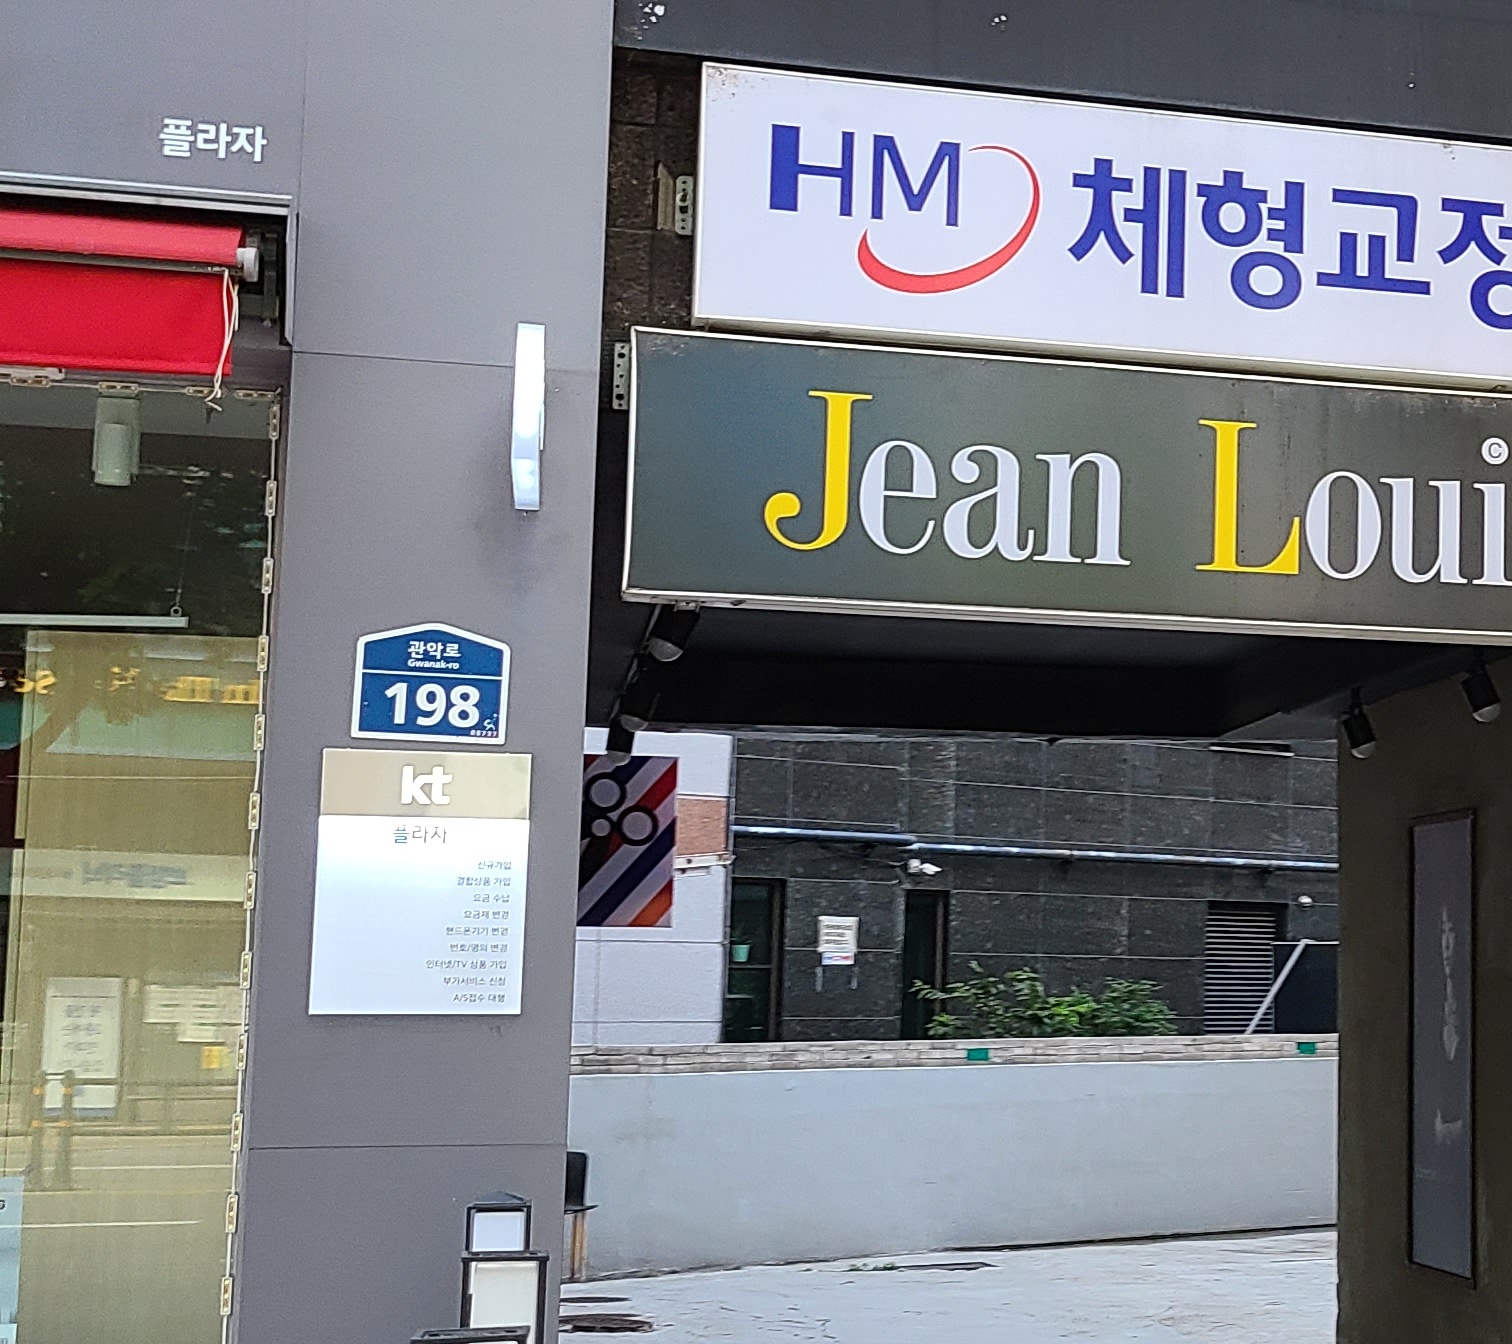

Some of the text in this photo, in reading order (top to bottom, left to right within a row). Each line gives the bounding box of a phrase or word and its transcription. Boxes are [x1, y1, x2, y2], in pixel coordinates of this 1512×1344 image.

[160, 118, 268, 163] 플라자
[769, 123, 961, 227] HM
[763, 389, 1132, 567] Jean
[407, 640, 462, 659] 관악로
[407, 659, 460, 670] Gwanak-ro
[384, 682, 481, 729] 198
[400, 764, 454, 806] kt
[392, 823, 448, 844] 플라자
